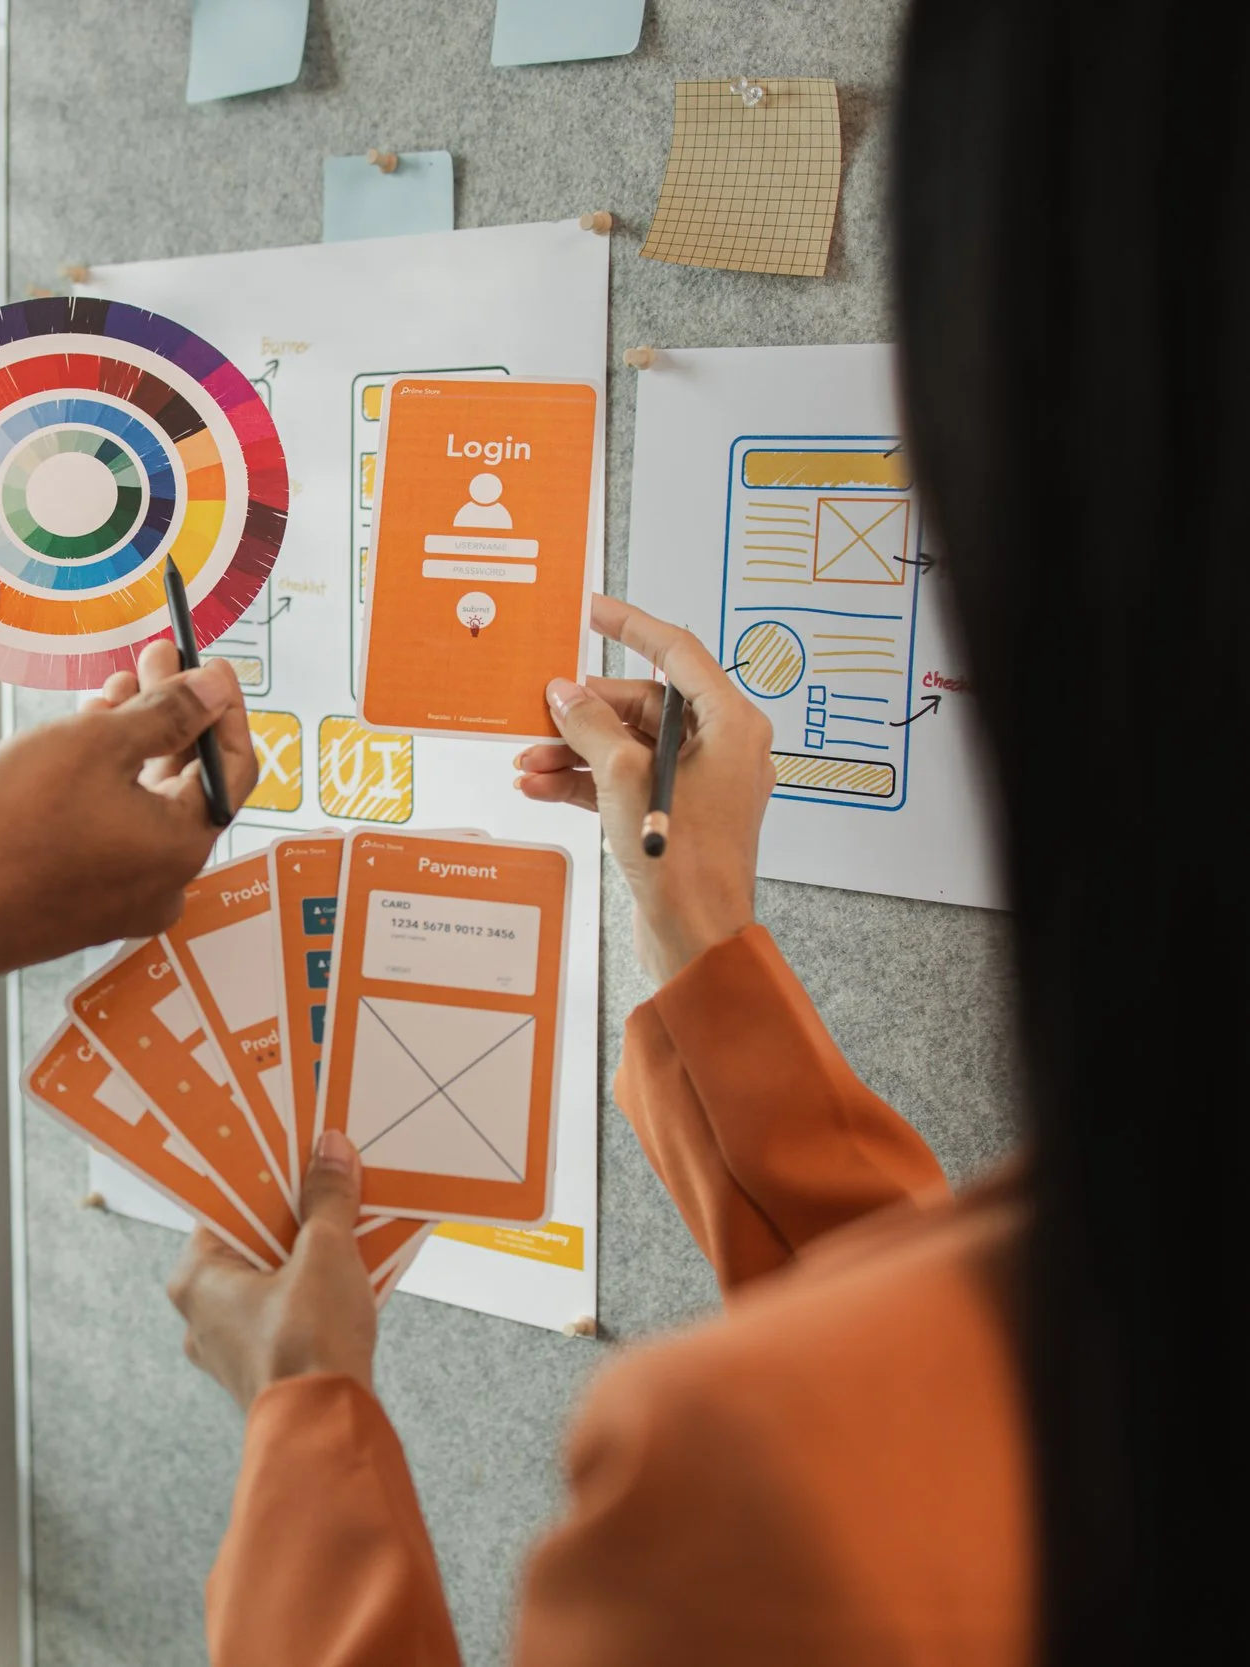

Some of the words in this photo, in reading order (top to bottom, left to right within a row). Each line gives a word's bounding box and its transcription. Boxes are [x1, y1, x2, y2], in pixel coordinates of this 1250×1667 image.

[447, 433, 531, 466] Login
[454, 541, 508, 552] USERNAME
[452, 566, 507, 577] PASSWORD
[461, 605, 490, 614] submit
[330, 737, 403, 799] UI
[417, 856, 498, 880] Payment
[381, 899, 411, 910] CARD
[392, 918, 419, 929] 1234
[423, 921, 451, 933] 5678
[455, 924, 483, 937] 9012
[487, 928, 515, 940] 3456
